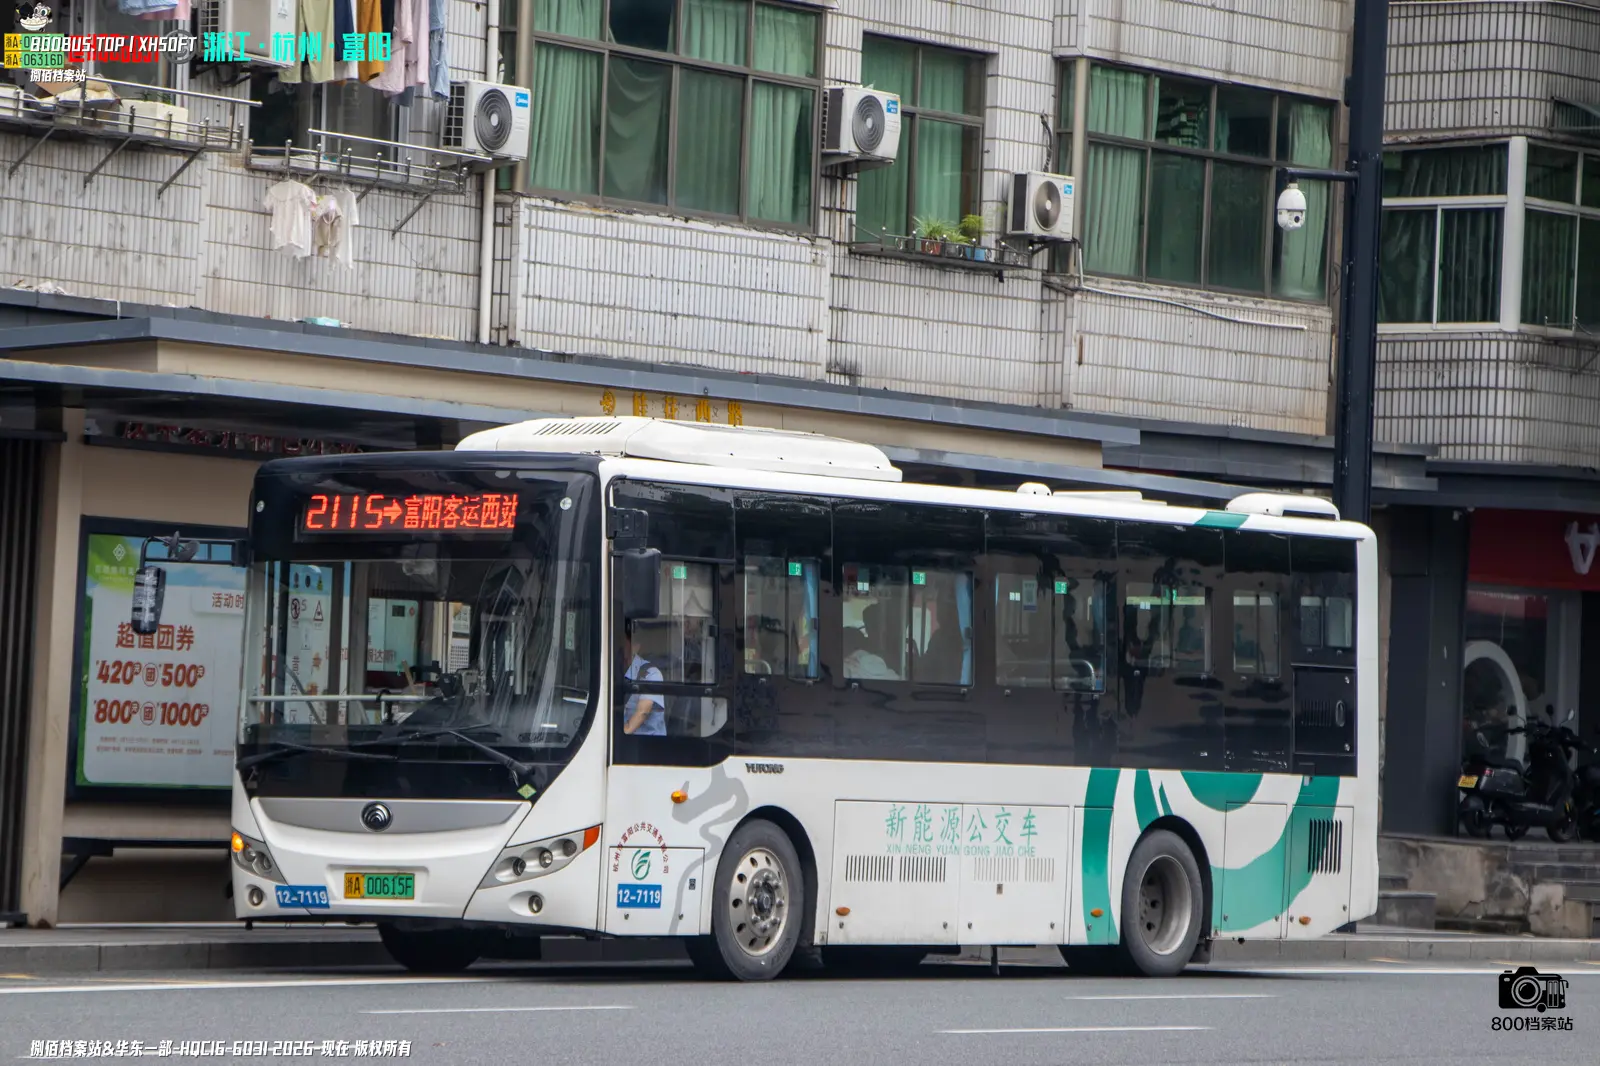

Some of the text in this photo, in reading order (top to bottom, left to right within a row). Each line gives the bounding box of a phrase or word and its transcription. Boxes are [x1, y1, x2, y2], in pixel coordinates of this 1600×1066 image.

[306, 494, 518, 528] 2115 富阳客运西站
[885, 804, 1038, 848] 新能源公交车
[886, 845, 1036, 858] XIN NENG YUAN GONG JIAO CHE
[277, 890, 328, 905] 12-7119
[618, 889, 661, 904] 12-7119
